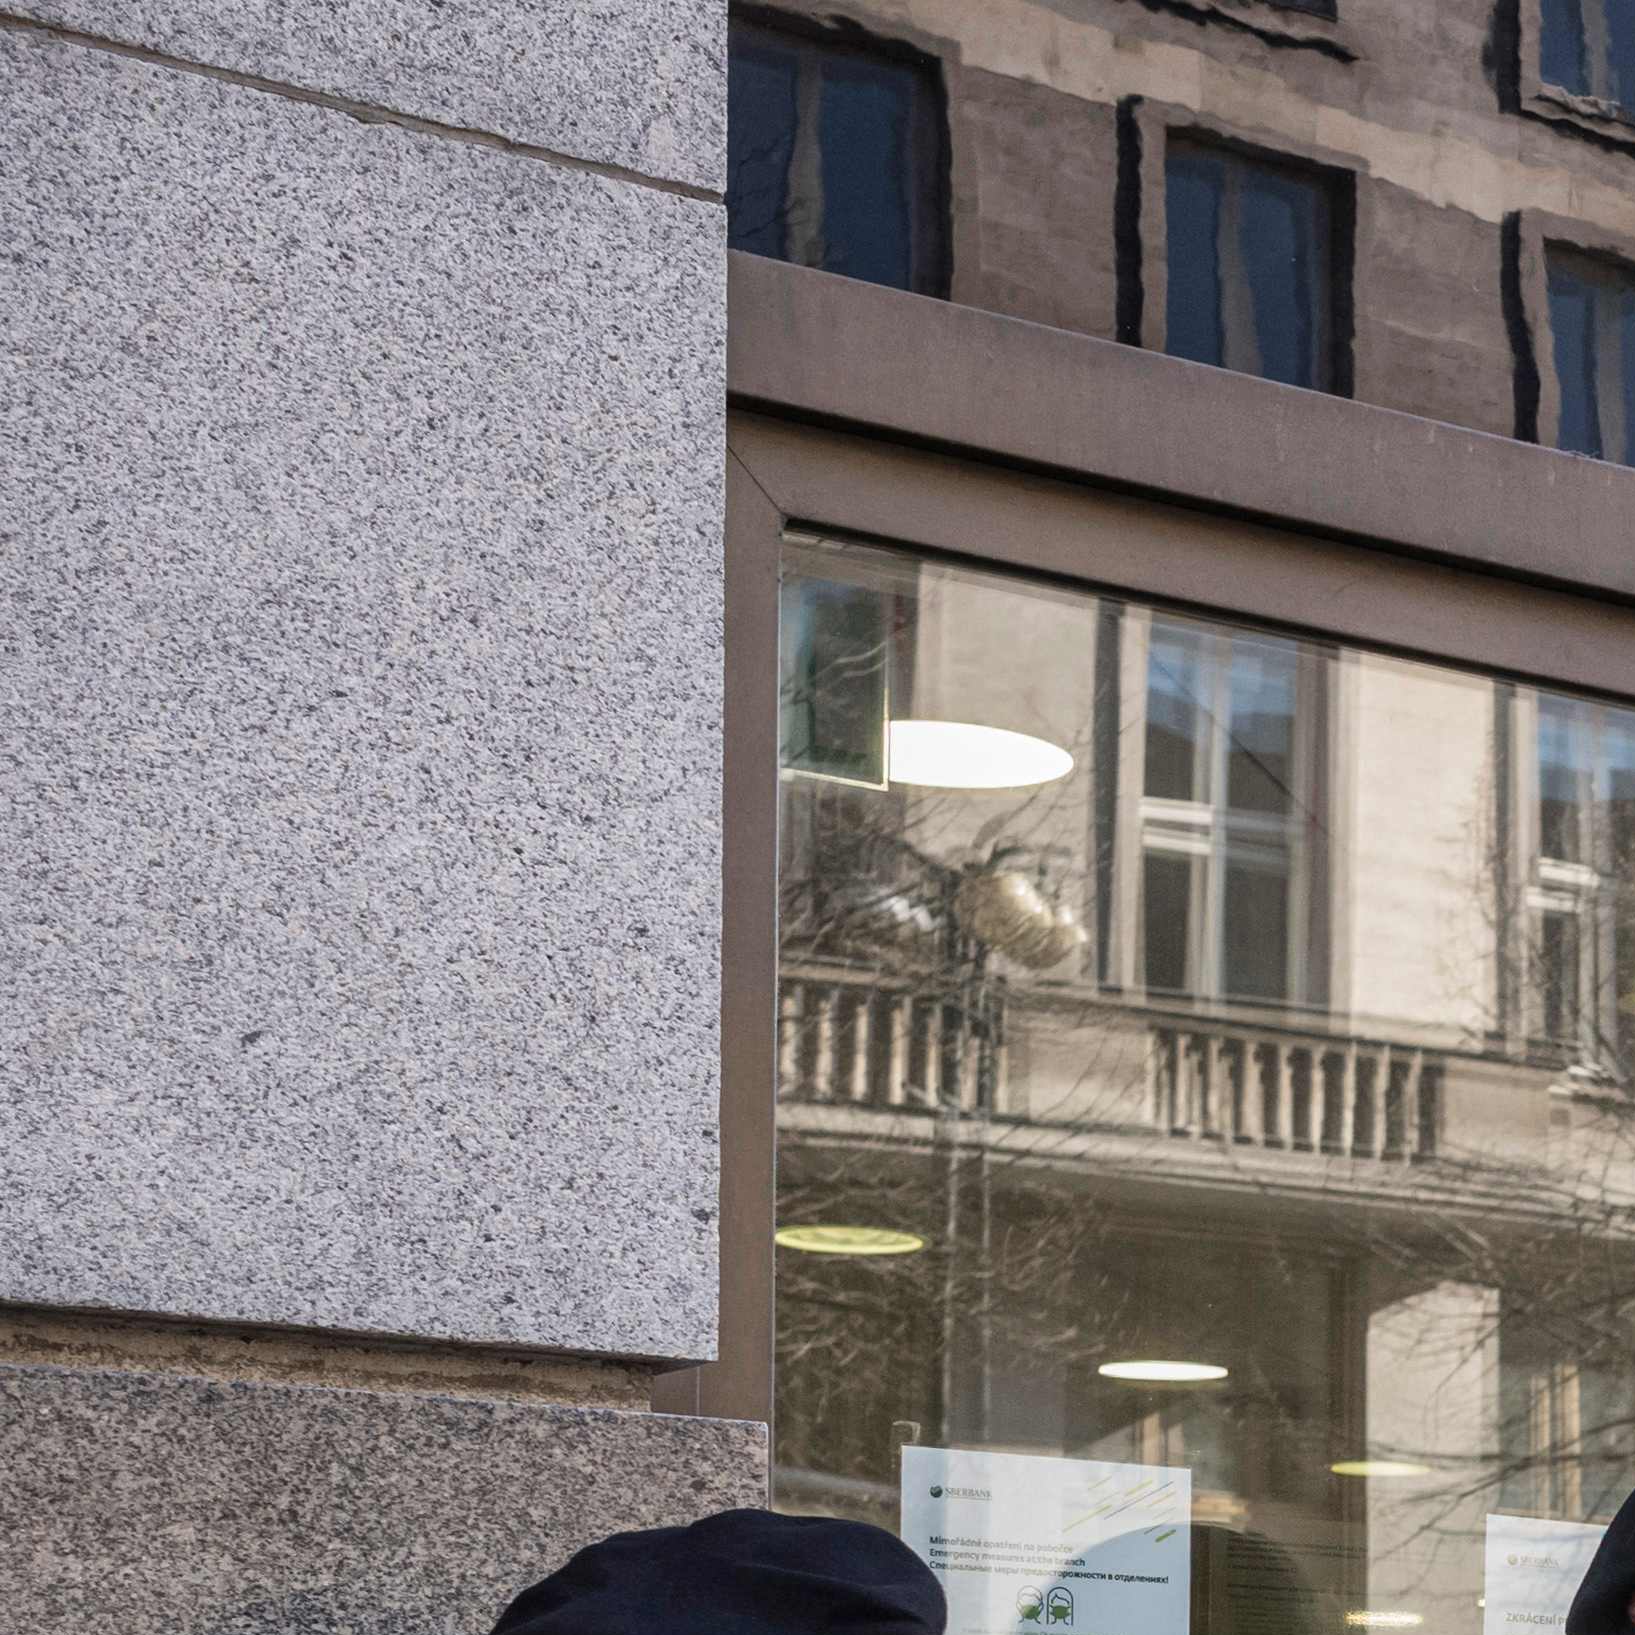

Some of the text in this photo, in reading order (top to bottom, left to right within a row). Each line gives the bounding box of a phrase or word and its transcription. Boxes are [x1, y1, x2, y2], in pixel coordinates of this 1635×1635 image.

[929, 1548, 980, 1562] Emergency
[1055, 1556, 1086, 1567] branch
[1505, 1611, 1556, 1626] ZKRÁCENÍ
